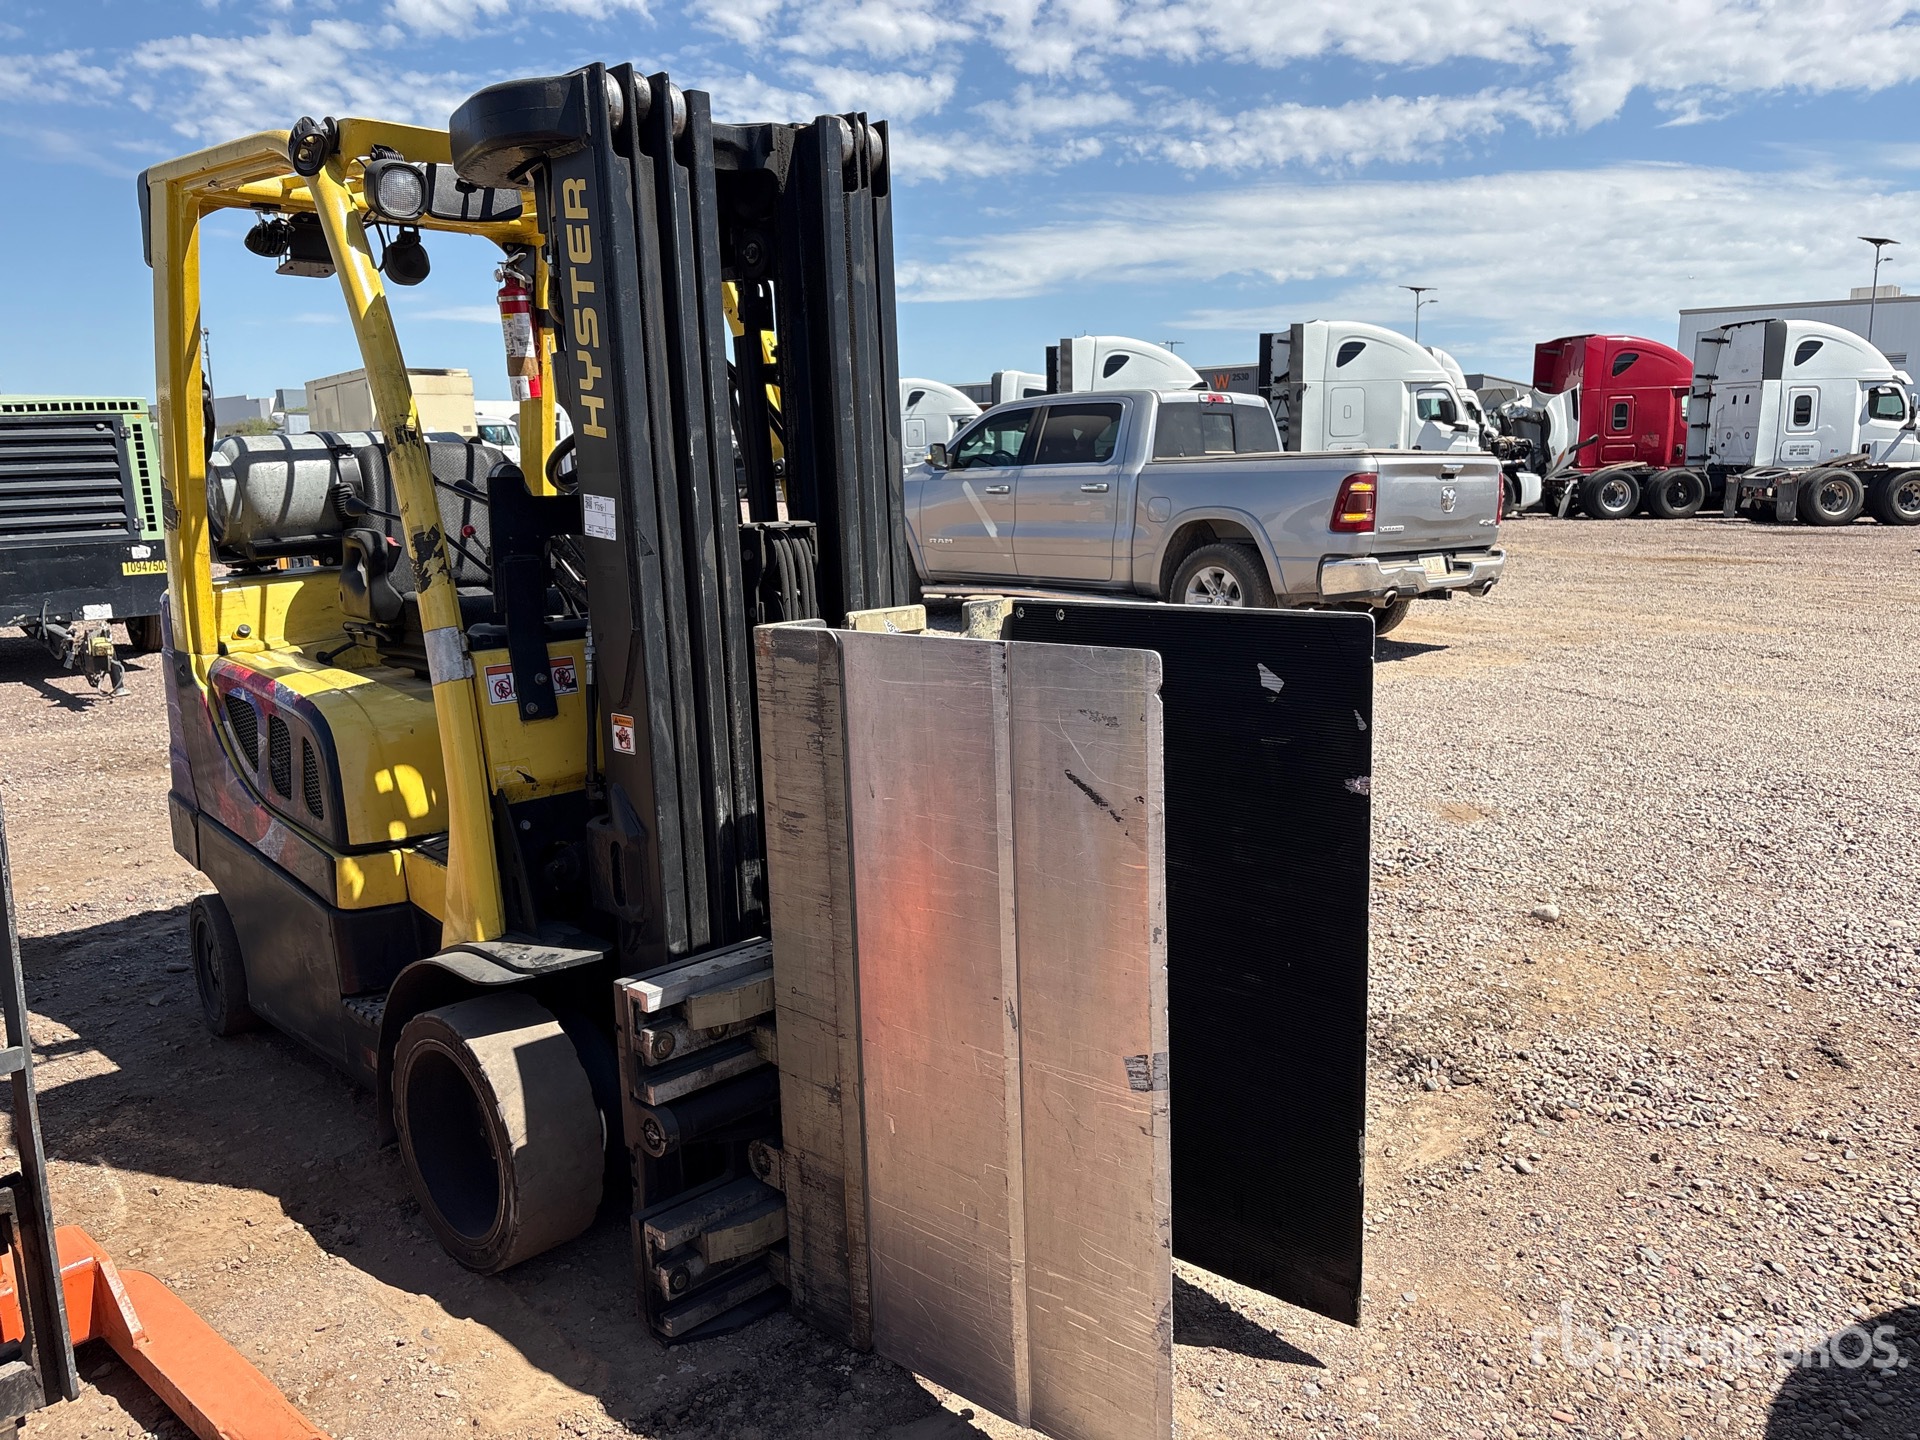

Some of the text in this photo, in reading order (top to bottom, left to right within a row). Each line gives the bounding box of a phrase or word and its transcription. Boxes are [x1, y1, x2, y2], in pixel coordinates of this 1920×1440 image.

[562, 177, 607, 439] HYSTER
[1214, 373, 1249, 390] W 2530
[125, 560, 168, 573] 1094750
